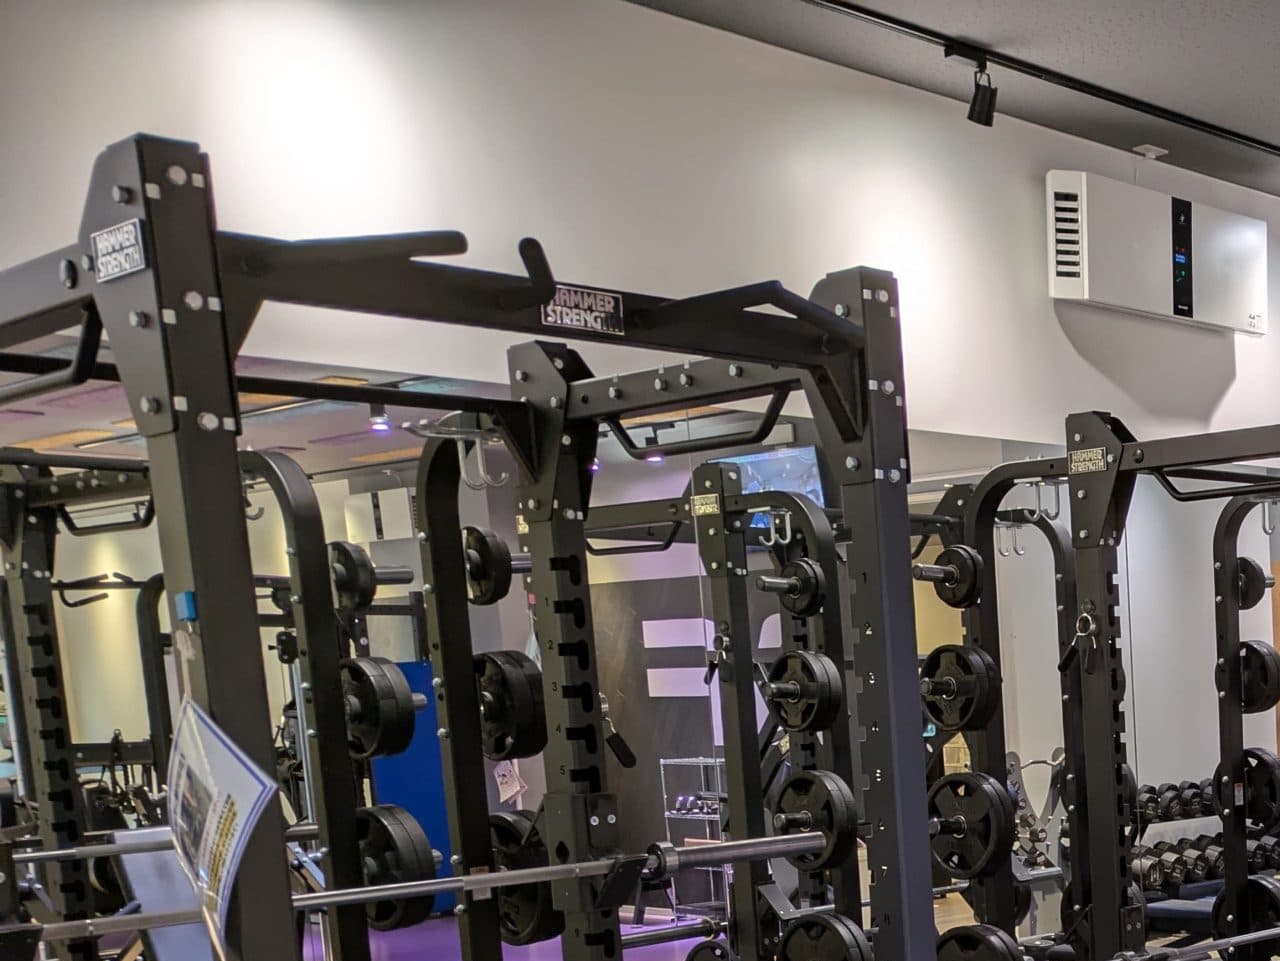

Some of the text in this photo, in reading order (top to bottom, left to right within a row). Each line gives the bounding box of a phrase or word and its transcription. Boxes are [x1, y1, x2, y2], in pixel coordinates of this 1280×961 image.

[96, 224, 136, 256] HAMMER
[98, 245, 142, 278] STRENGTH
[1071, 450, 1103, 462] HAMMER
[1071, 459, 1104, 473] STRENGTH
